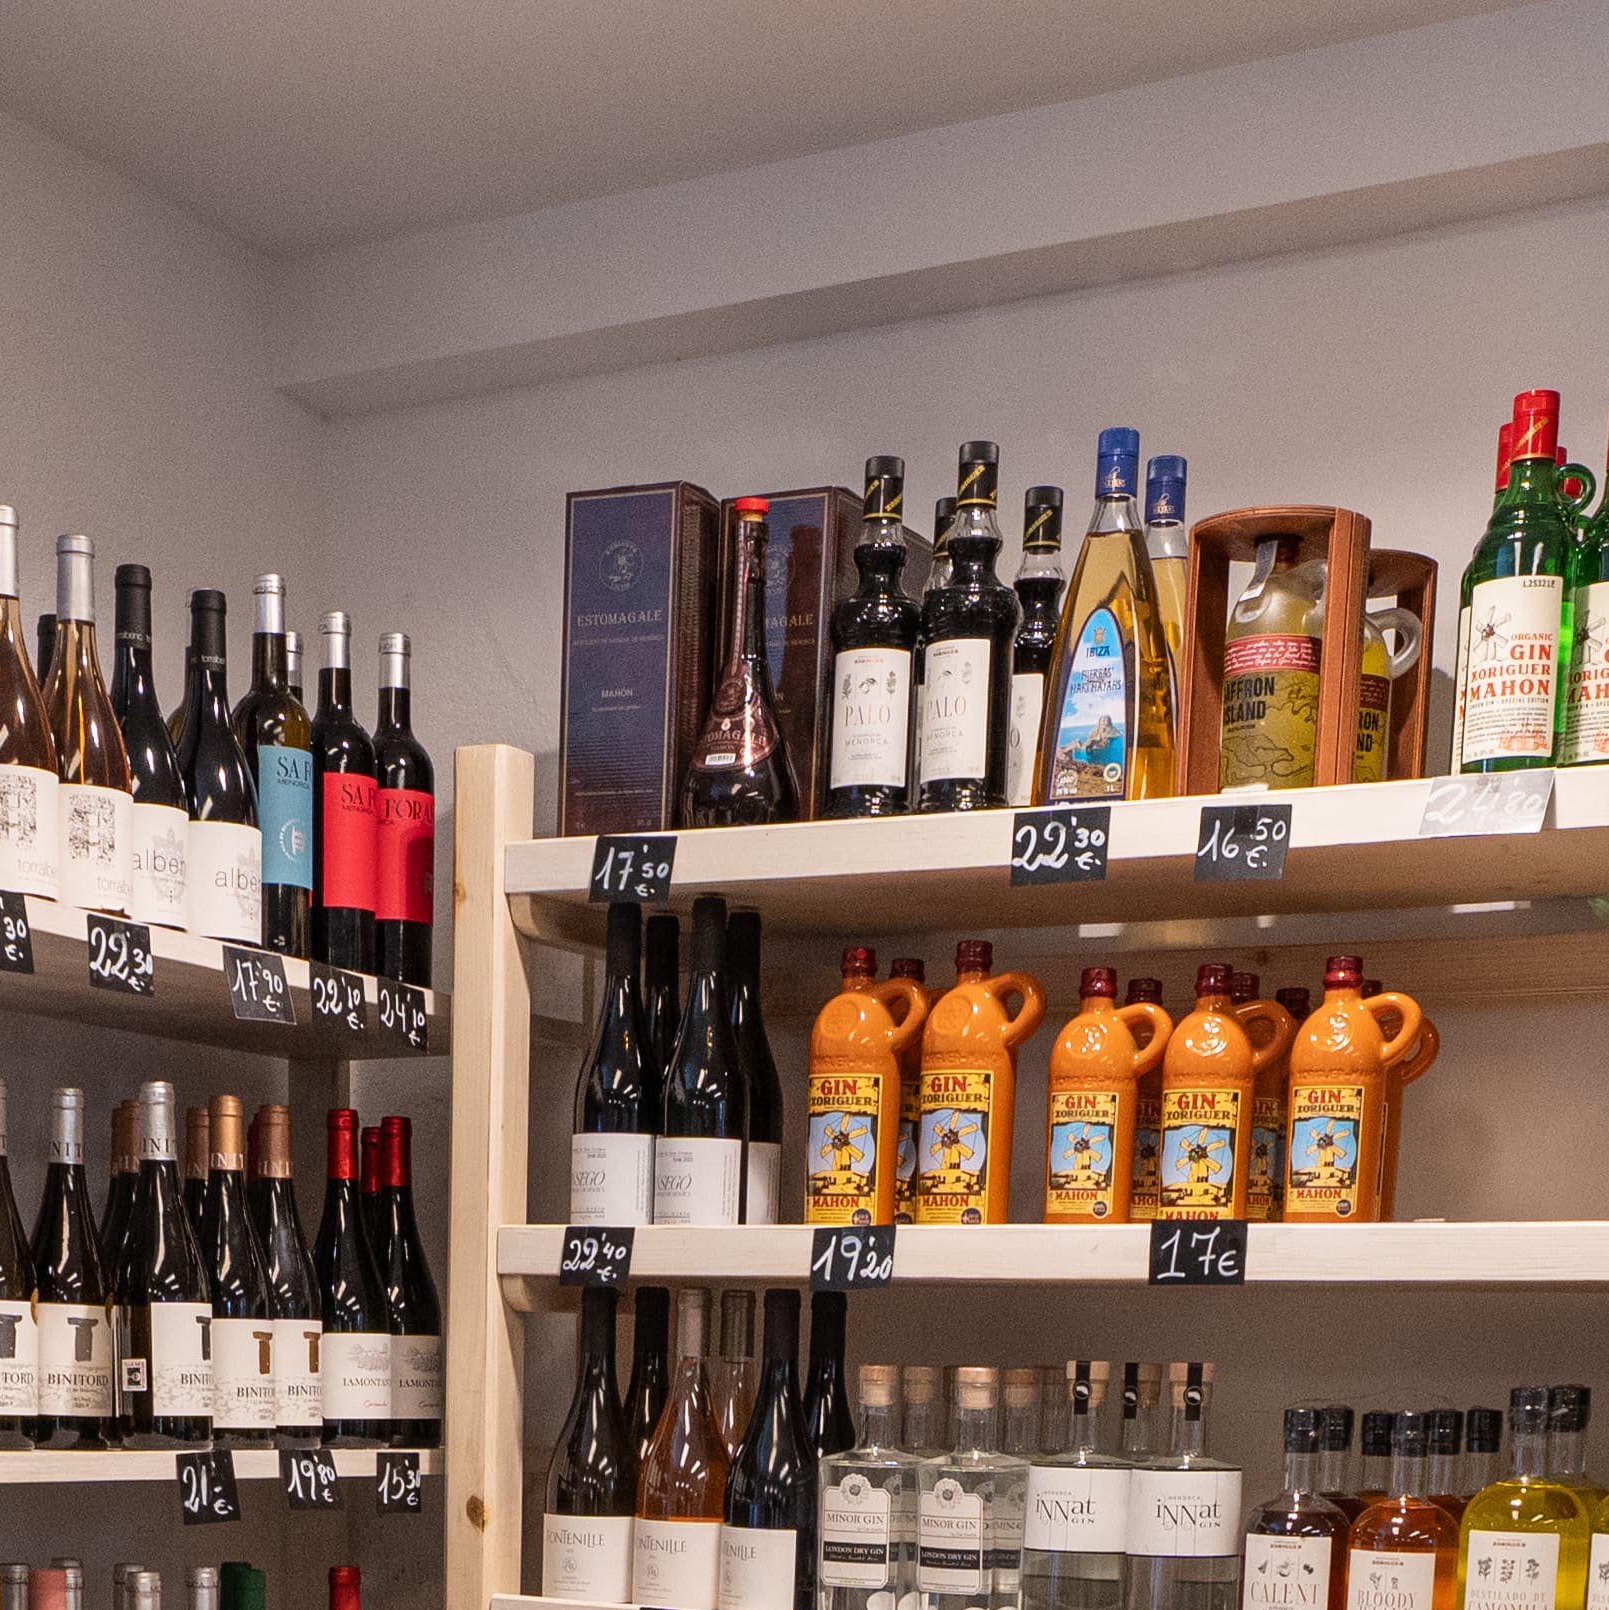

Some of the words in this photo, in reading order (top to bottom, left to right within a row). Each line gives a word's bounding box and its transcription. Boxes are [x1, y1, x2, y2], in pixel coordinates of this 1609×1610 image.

[576, 609, 663, 628] ESTOMAGALE
[1510, 631, 1554, 642] ORGANIC
[1509, 644, 1553, 662] GIN
[1470, 663, 1552, 683] XORIGUER
[1469, 679, 1550, 702] MAHON
[844, 703, 892, 728] PALO
[819, 1078, 858, 1096] GIN
[811, 1195, 860, 1209] MAHON
[922, 1195, 970, 1208] MAHON
[46, 1372, 110, 1387] BINITORD
[825, 1512, 864, 1526] MINOR
[921, 1518, 955, 1531] MINOR
[1249, 1580, 1321, 1605] CALENT
[1356, 1590, 1417, 1608] BLOODY
